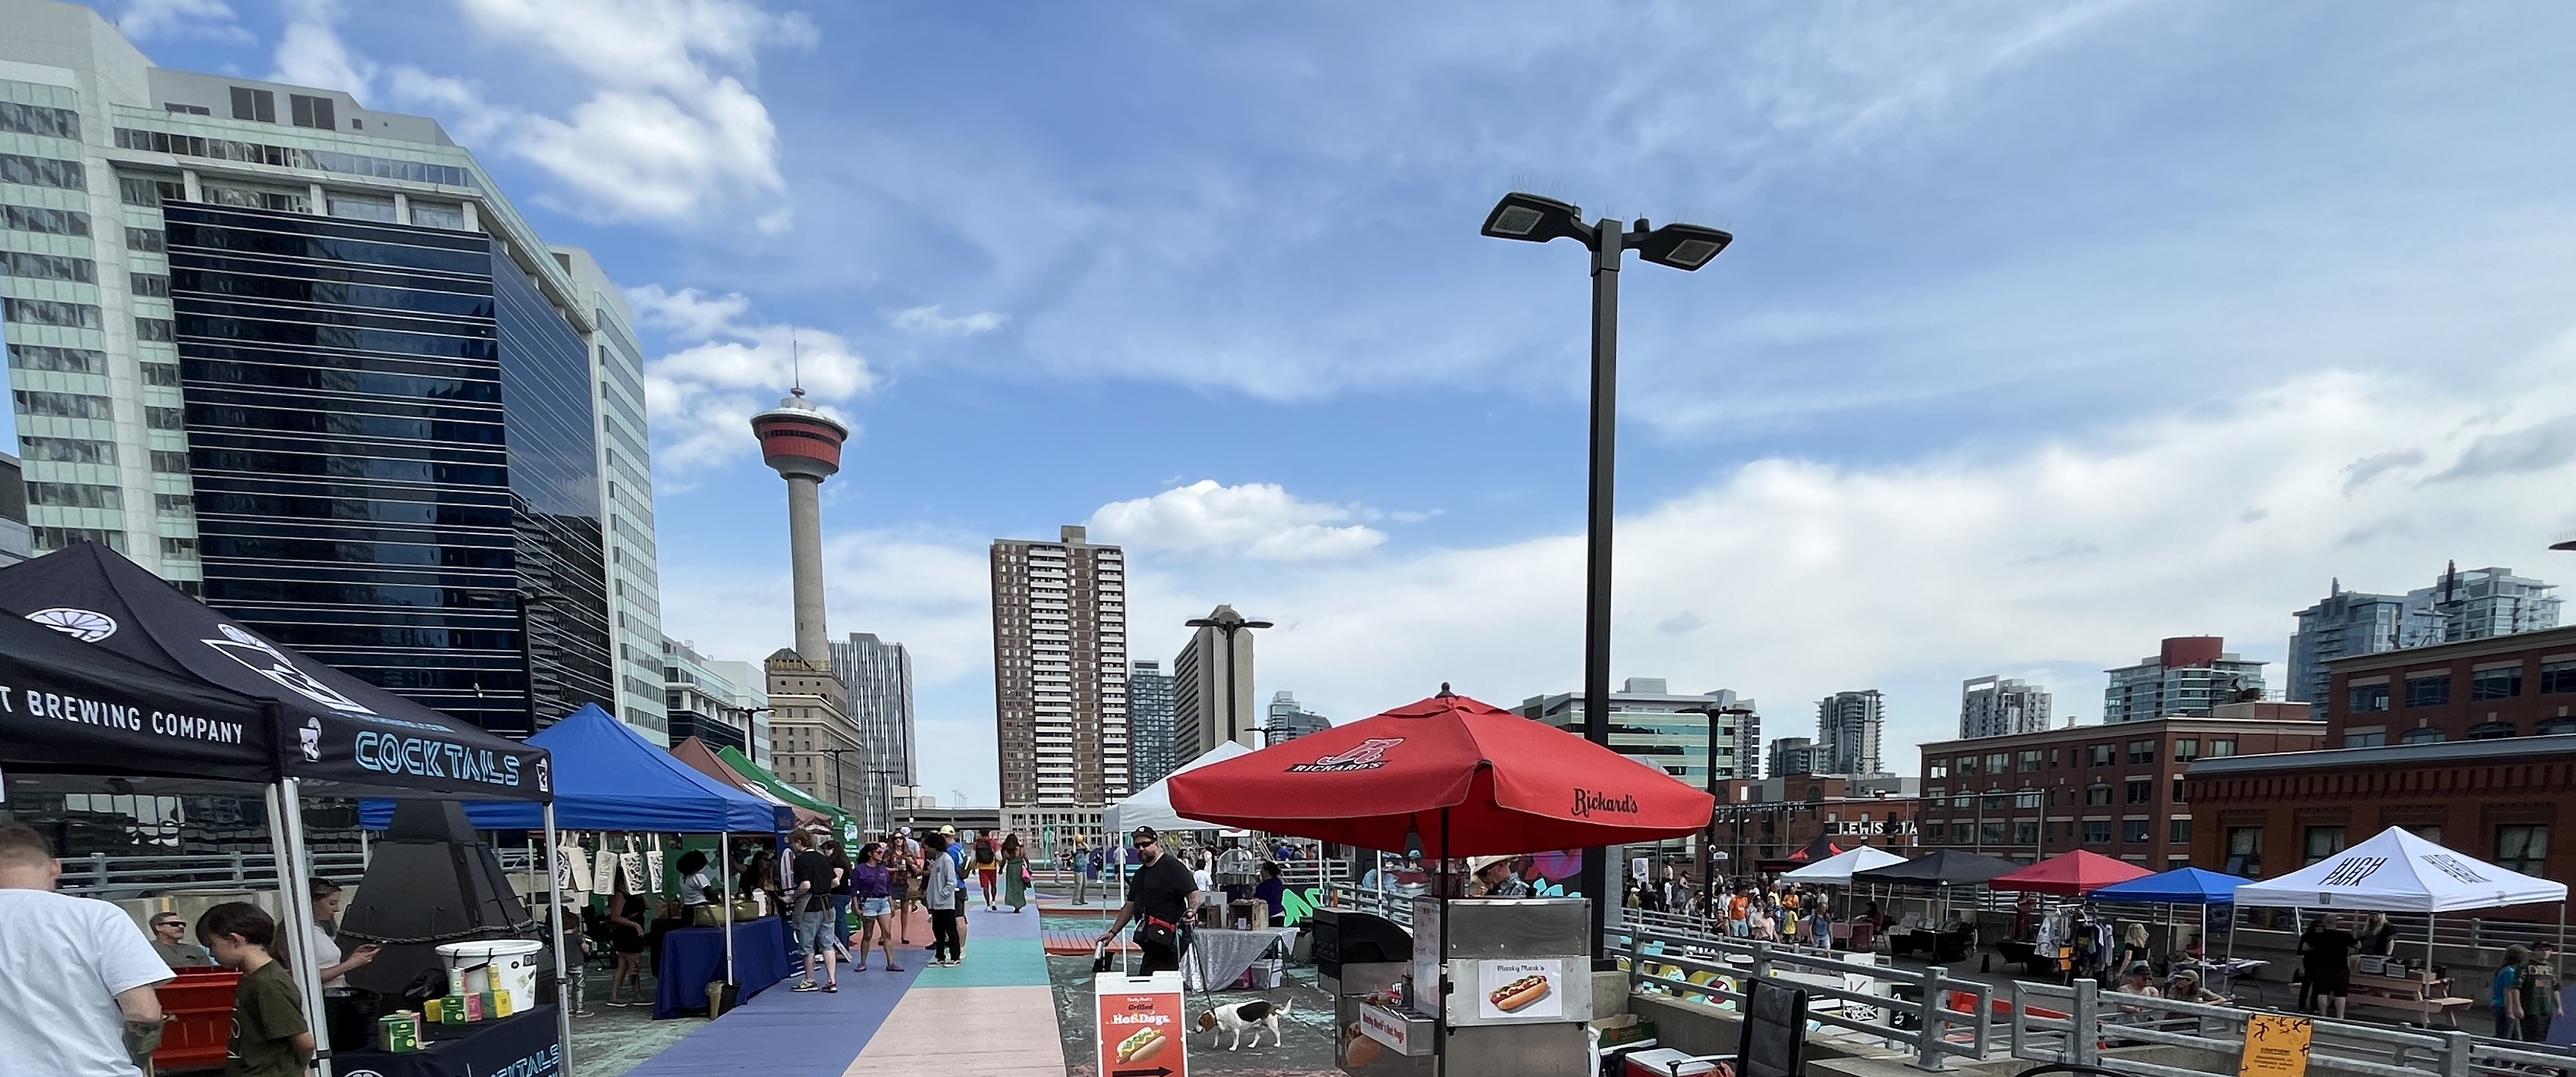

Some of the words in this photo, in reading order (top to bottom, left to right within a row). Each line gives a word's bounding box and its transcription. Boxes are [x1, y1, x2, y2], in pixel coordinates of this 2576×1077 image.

[27, 690, 141, 731] BREWING
[152, 711, 243, 744] COMPANY
[355, 731, 520, 786] COCKTAILS
[1293, 761, 1382, 773] RICKARD'S
[1571, 787, 1638, 818] Rickard's
[1839, 822, 1883, 834] LEWIS
[2331, 857, 2388, 874] HIGH
[2317, 872, 2365, 887] PARK
[1497, 965, 1519, 974] Marky
[1521, 964, 1544, 972] Mark's
[1112, 1013, 1136, 1024] Hot
[1139, 1013, 1170, 1026] Dogs
